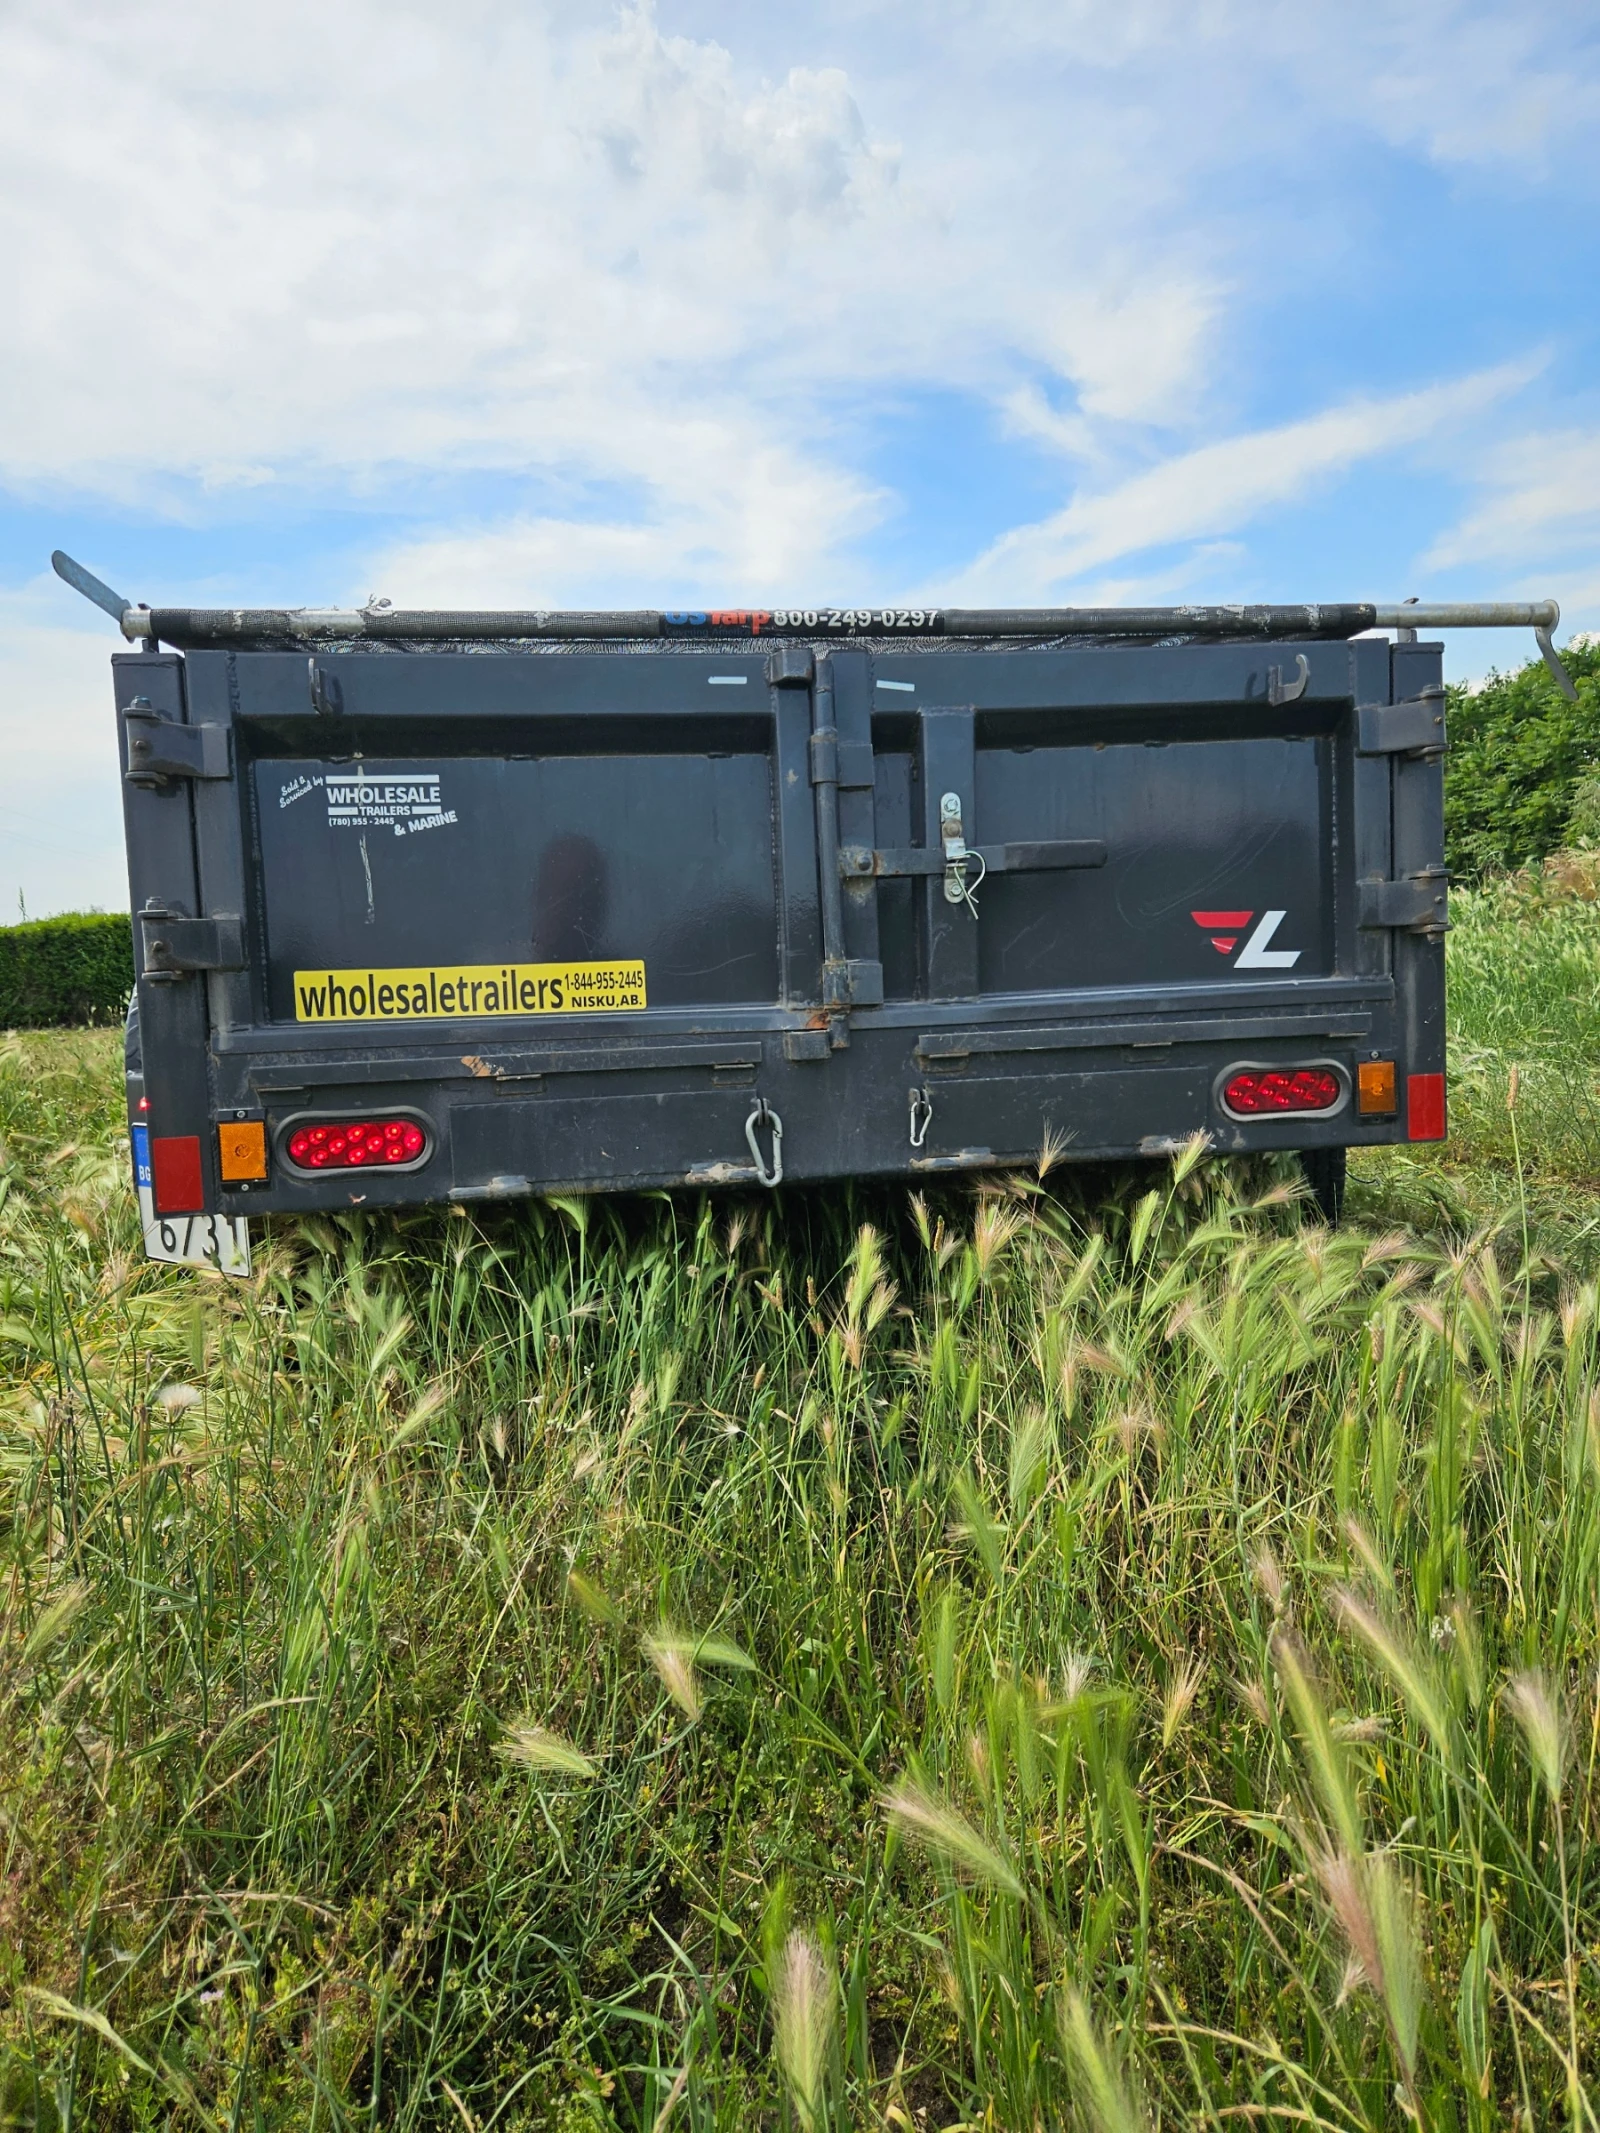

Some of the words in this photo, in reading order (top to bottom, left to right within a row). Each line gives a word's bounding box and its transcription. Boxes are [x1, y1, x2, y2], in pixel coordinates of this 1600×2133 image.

[710, 610, 770, 635] Tarp
[774, 610, 939, 627] 800-249-0297
[279, 779, 313, 809] Serviced
[312, 775, 324, 786] by
[281, 779, 300, 796] Sold
[299, 775, 306, 785] &
[326, 787, 441, 804] WHOLESALE
[359, 805, 411, 816] TRAILERS
[328, 817, 351, 827] (780)
[352, 817, 368, 826] 955
[374, 817, 395, 826] 2445
[394, 824, 406, 836] &
[408, 810, 458, 833] MARINE
[564, 970, 644, 991] 1-844-955-2445
[300, 969, 563, 1018] wholesaletrailers
[138, 1165, 151, 1182] BG
